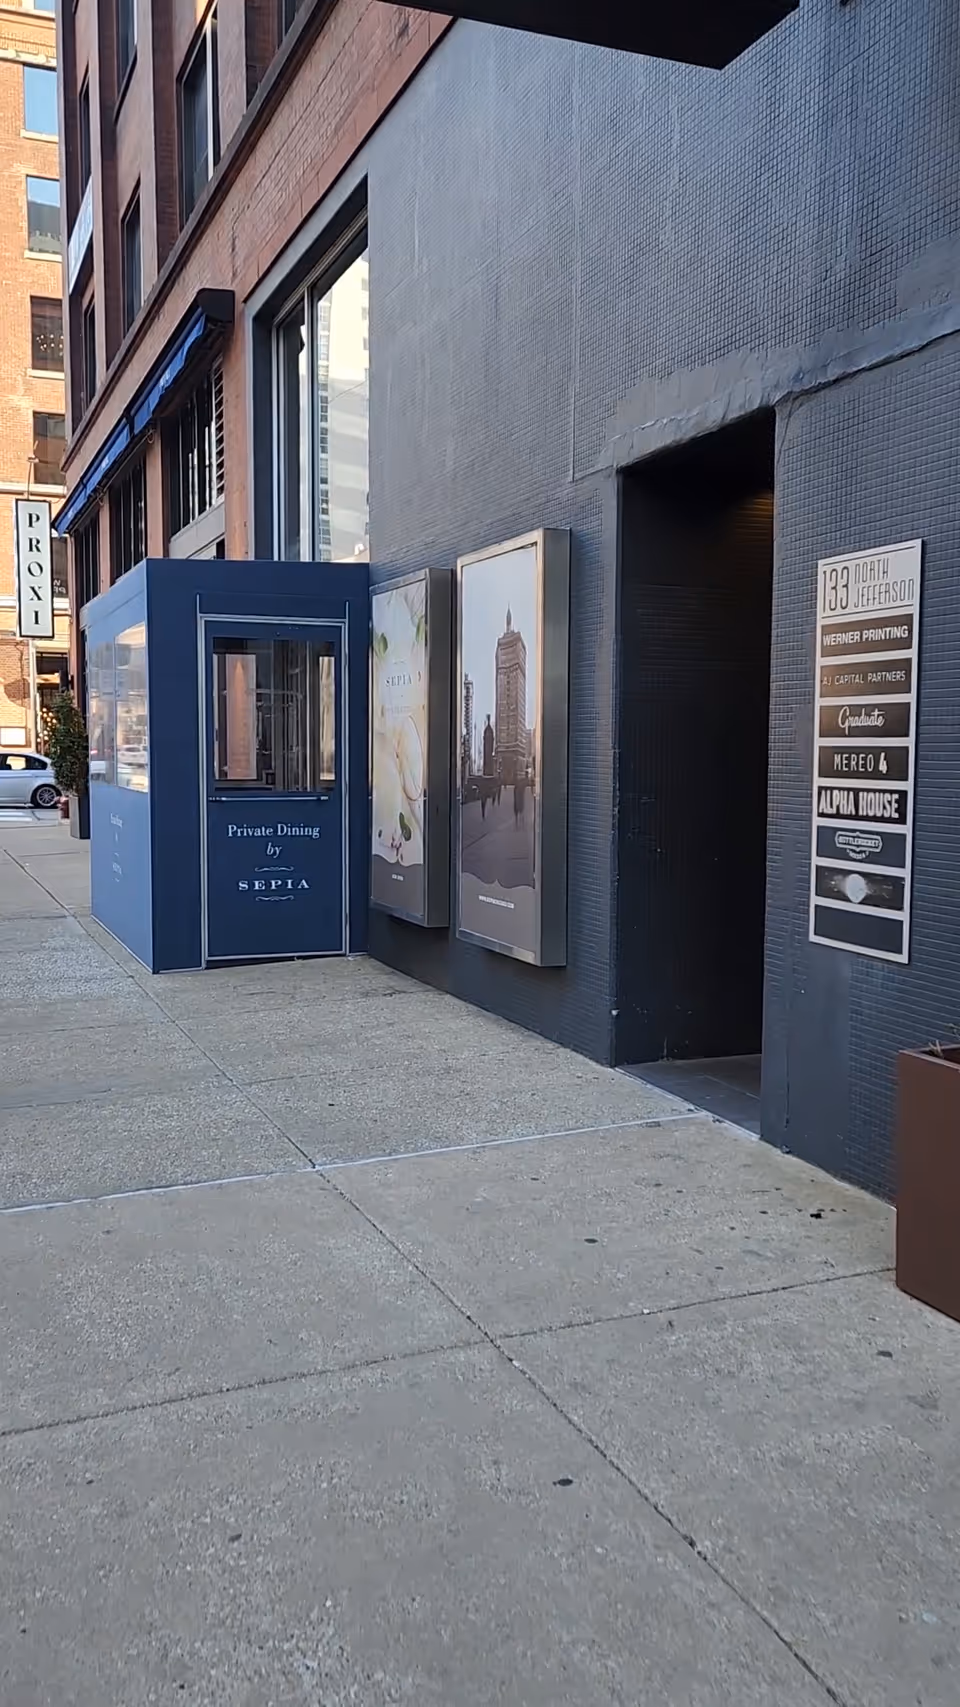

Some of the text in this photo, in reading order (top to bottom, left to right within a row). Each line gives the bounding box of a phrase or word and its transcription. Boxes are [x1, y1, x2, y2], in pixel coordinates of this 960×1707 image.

[27, 512, 44, 625] PROXI
[823, 558, 889, 613] 133 NORTH
[854, 578, 914, 608] JEFFERSON
[823, 625, 909, 646] WERNER PRINTING
[385, 674, 412, 687] SEPIA
[834, 673, 864, 685] CAPITAL
[867, 670, 906, 683] PARTNERS
[838, 706, 885, 735] Graduate
[834, 752, 888, 774] MEREO 4
[819, 789, 900, 818] ALPHA HOUSE
[227, 823, 320, 839] Private Dining
[266, 842, 282, 859] by
[238, 879, 310, 891] SEPIA
